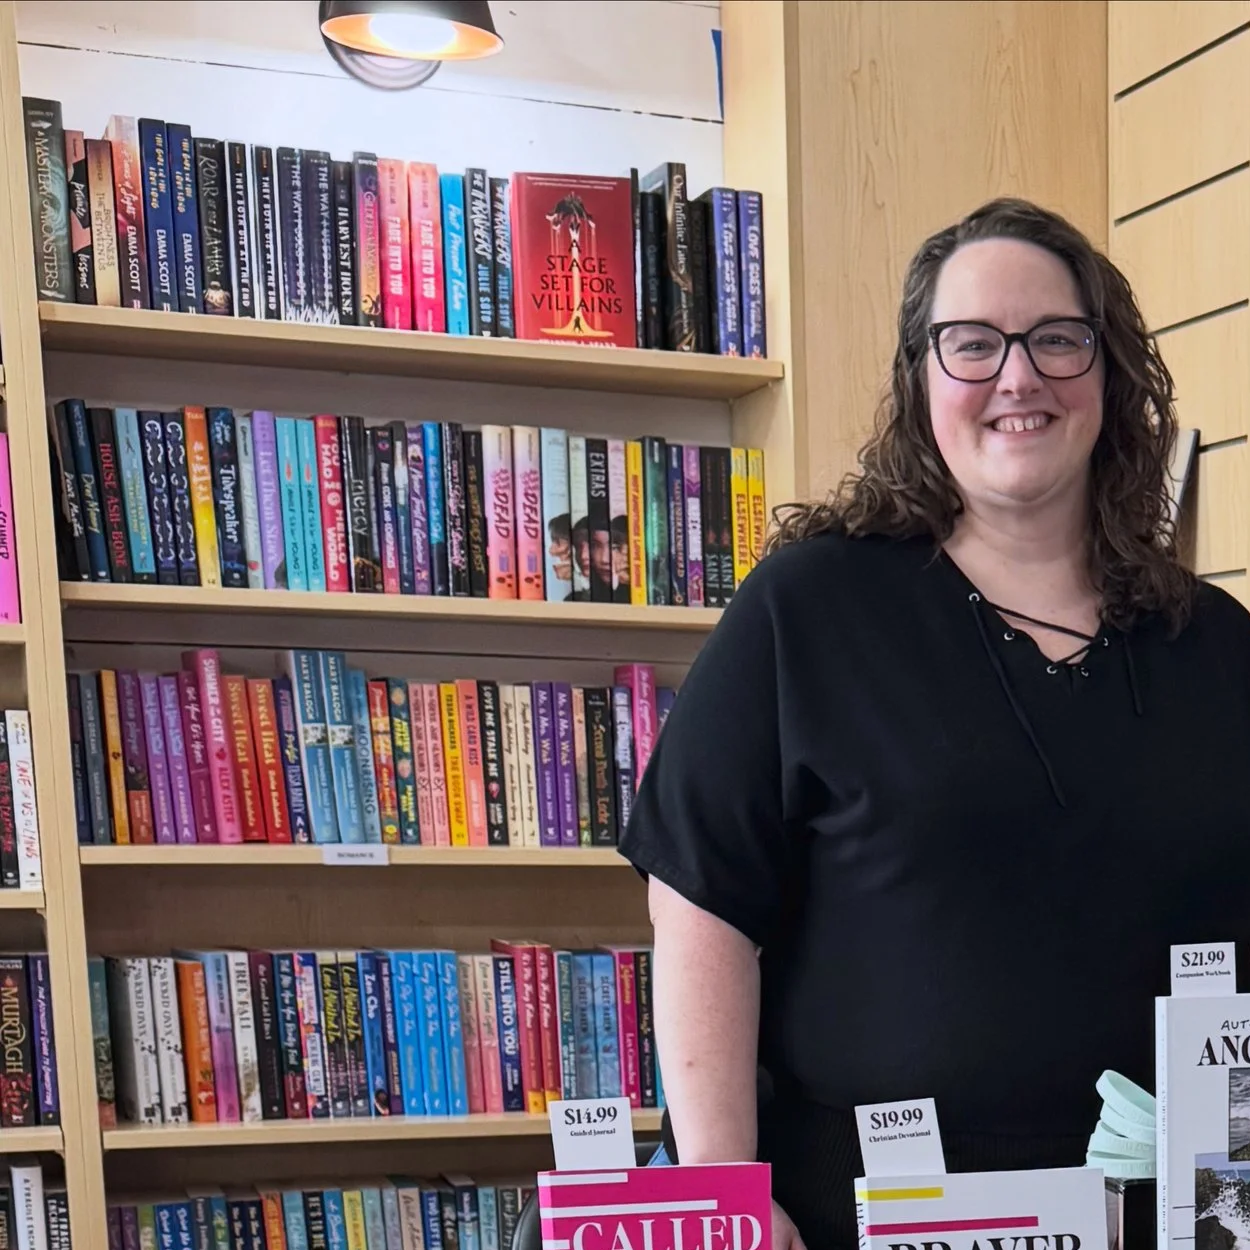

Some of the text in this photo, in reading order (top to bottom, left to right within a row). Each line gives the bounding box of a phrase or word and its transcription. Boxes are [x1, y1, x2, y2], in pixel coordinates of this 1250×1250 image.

[673, 173, 687, 240] Our Infinite
[126, 226, 137, 258] EMMA
[156, 229, 171, 295] EMMA SCOTT
[337, 206, 353, 317] HARVEST HOUSE
[129, 260, 141, 292] SCOTT
[182, 233, 197, 299] EMMA SCOTT
[478, 263, 491, 294] JULIE
[540, 275, 617, 295] SET FOR
[546, 254, 609, 275] STAGE
[480, 296, 492, 324] SOTO
[531, 293, 623, 315] VILLAINS
[99, 443, 118, 490] HOUSE
[589, 452, 606, 499] EXTRAS
[493, 491, 511, 540] DEAD
[522, 491, 540, 540] DEAD
[735, 493, 750, 567] ELSEWHERE
[326, 509, 348, 583] HELLO WORLD
[705, 552, 720, 590] SAINT
[720, 553, 734, 590] SAINT
[256, 684, 272, 727] Sweet
[482, 685, 499, 778] LOVE ME STALK ME
[357, 723, 376, 816] MOONRISING
[1181, 950, 1226, 969] $21.99
[364, 973, 379, 1020] Zen Cho
[499, 961, 517, 1057] STILL INTO YOU
[0, 986, 26, 1074] MURTAGH
[563, 1106, 618, 1126] $14.99
[868, 1129, 932, 1143] Christian Devotional
[870, 1107, 924, 1131] $19.99
[159, 1209, 170, 1234] Drive
[177, 1207, 188, 1231] Drive
